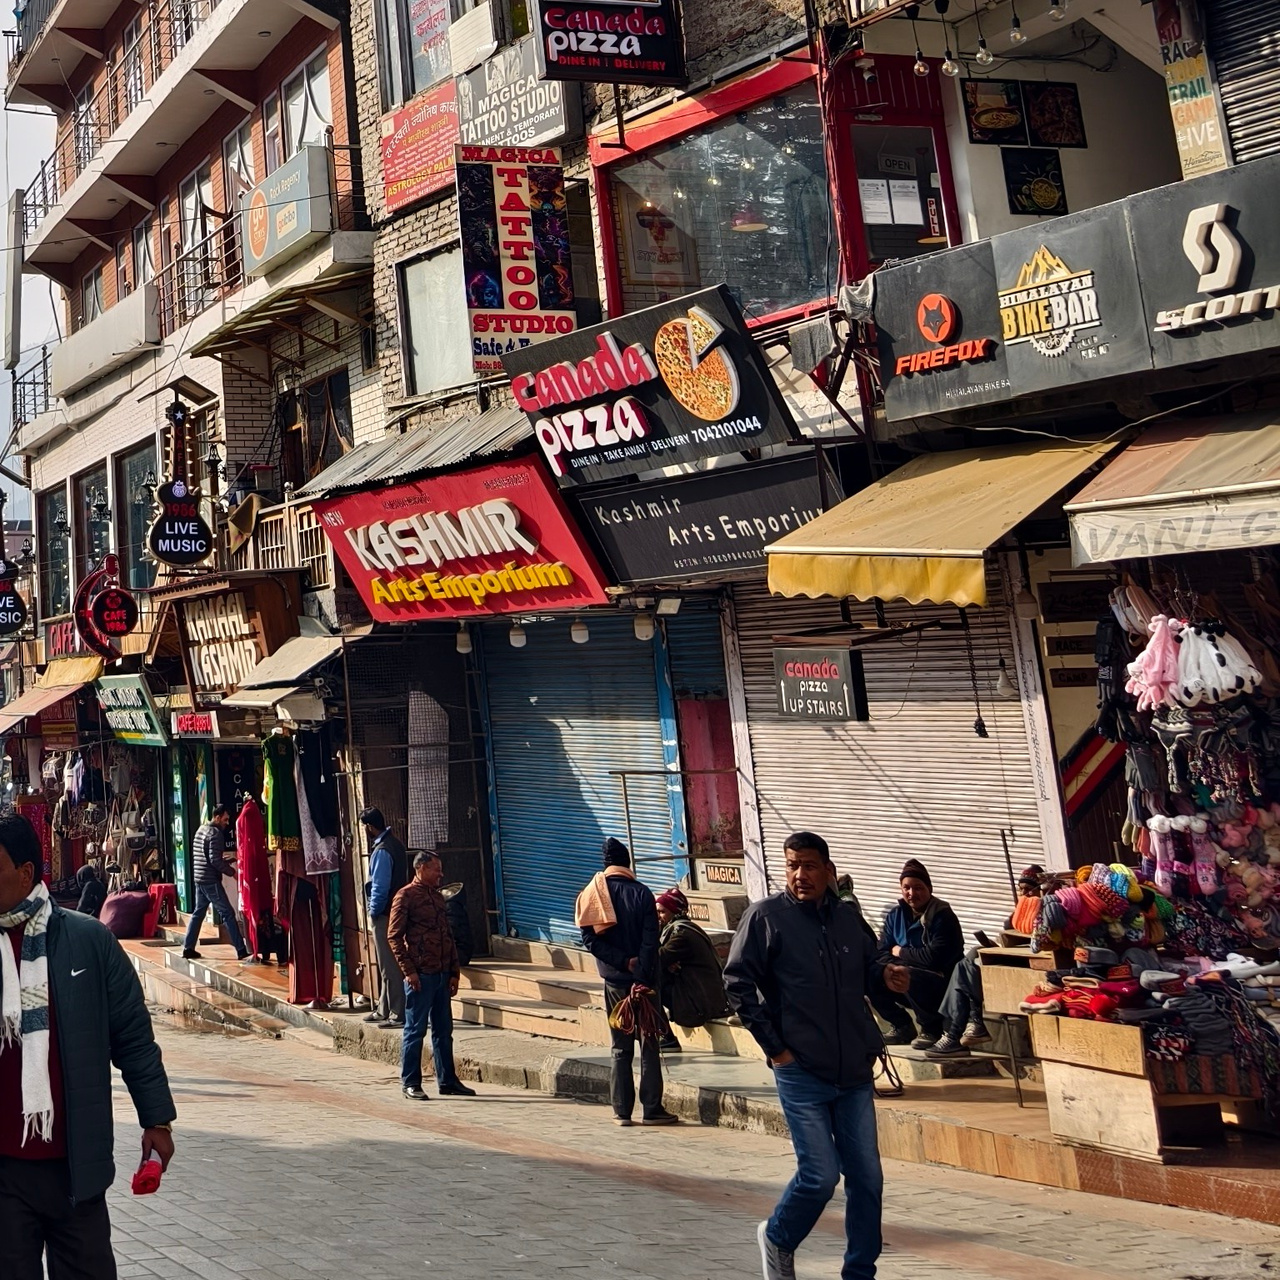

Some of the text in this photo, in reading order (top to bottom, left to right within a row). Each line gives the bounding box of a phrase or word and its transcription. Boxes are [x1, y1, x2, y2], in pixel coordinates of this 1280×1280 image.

[547, 31, 641, 61] pizza
[1161, 41, 1203, 66] RAC
[559, 56, 666, 71] DINE IN DELIVERY
[478, 75, 539, 114] MAGICA
[1169, 77, 1212, 102] TRAIL
[461, 81, 560, 145] TATTOO STUDIO
[513, 106, 560, 133] TEMPORARY
[1174, 97, 1217, 128] CAMP
[1177, 121, 1219, 151] LIVE
[461, 146, 560, 165] MAGICA
[884, 158, 911, 171] OPEN
[387, 168, 433, 198] ASTROLOGY
[253, 202, 264, 231] go
[928, 199, 940, 235] PULL
[496, 167, 538, 310] TATTOO
[999, 275, 1094, 308] HIMALAYAN
[473, 313, 574, 334] STUDIO
[473, 338, 504, 356] Safe
[895, 337, 990, 376] FIREFOX
[945, 384, 984, 399] HIMALAYAN
[984, 380, 1000, 394] BIKE
[535, 395, 652, 478] pizza
[570, 415, 762, 468] DINE IN TAKE AWAY DELIVERY 7042101044
[166, 503, 197, 517] 1986
[322, 510, 345, 528] NEW
[594, 495, 682, 526] Kashmir
[165, 521, 199, 535] LIVE
[344, 498, 540, 573] KASHMIR
[668, 522, 717, 547] Arts
[1089, 514, 1217, 560] VANI
[158, 538, 207, 553] MUSIC
[371, 560, 575, 606] Arts Emporium
[103, 609, 127, 621] CAFE
[105, 621, 128, 632] 1986
[50, 621, 75, 657] CAFE
[785, 657, 841, 680] canada
[799, 680, 829, 696] pizza
[789, 698, 844, 716] UP STAIRS
[706, 865, 741, 883] MAGICA
